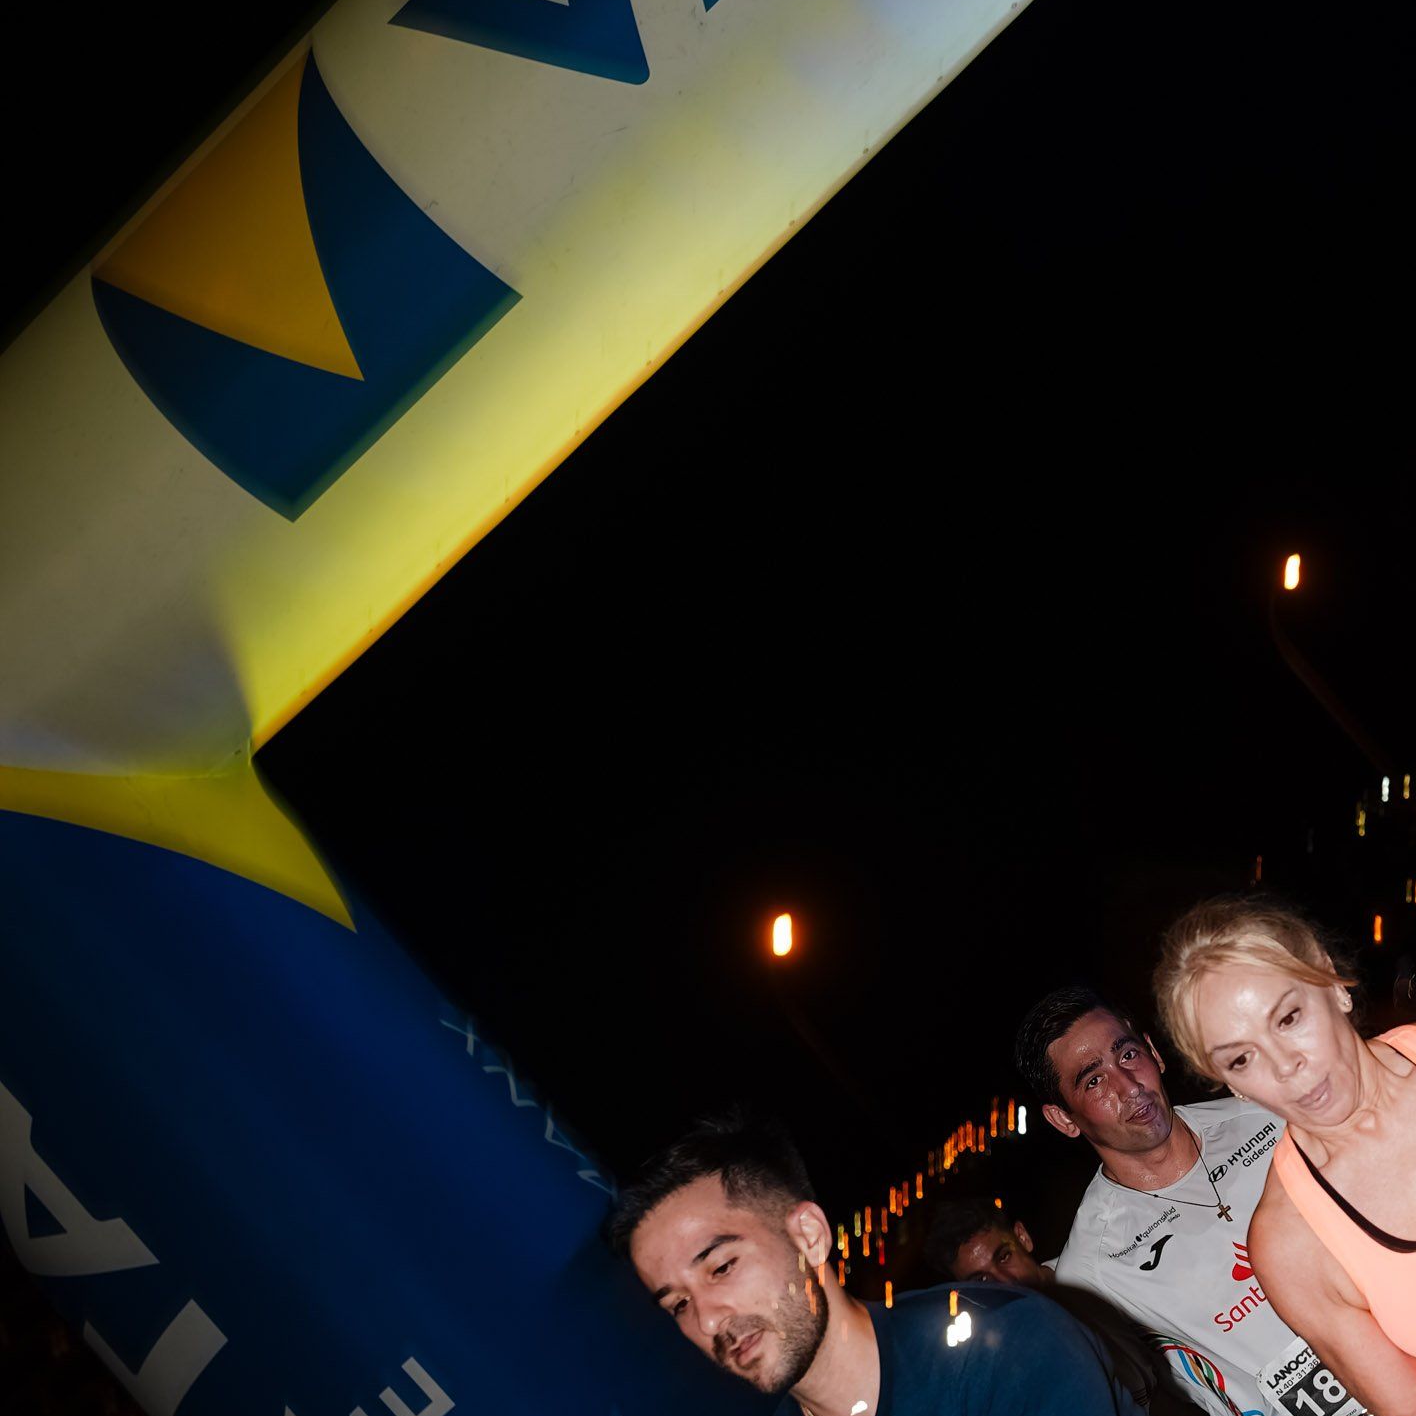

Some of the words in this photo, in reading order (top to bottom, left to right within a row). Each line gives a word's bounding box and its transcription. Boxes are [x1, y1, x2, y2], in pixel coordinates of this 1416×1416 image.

[1226, 1121, 1277, 1167] HYUNDAI
[1241, 1134, 1278, 1169] Gidecar
[1296, 1368, 1308, 1379] 31'
